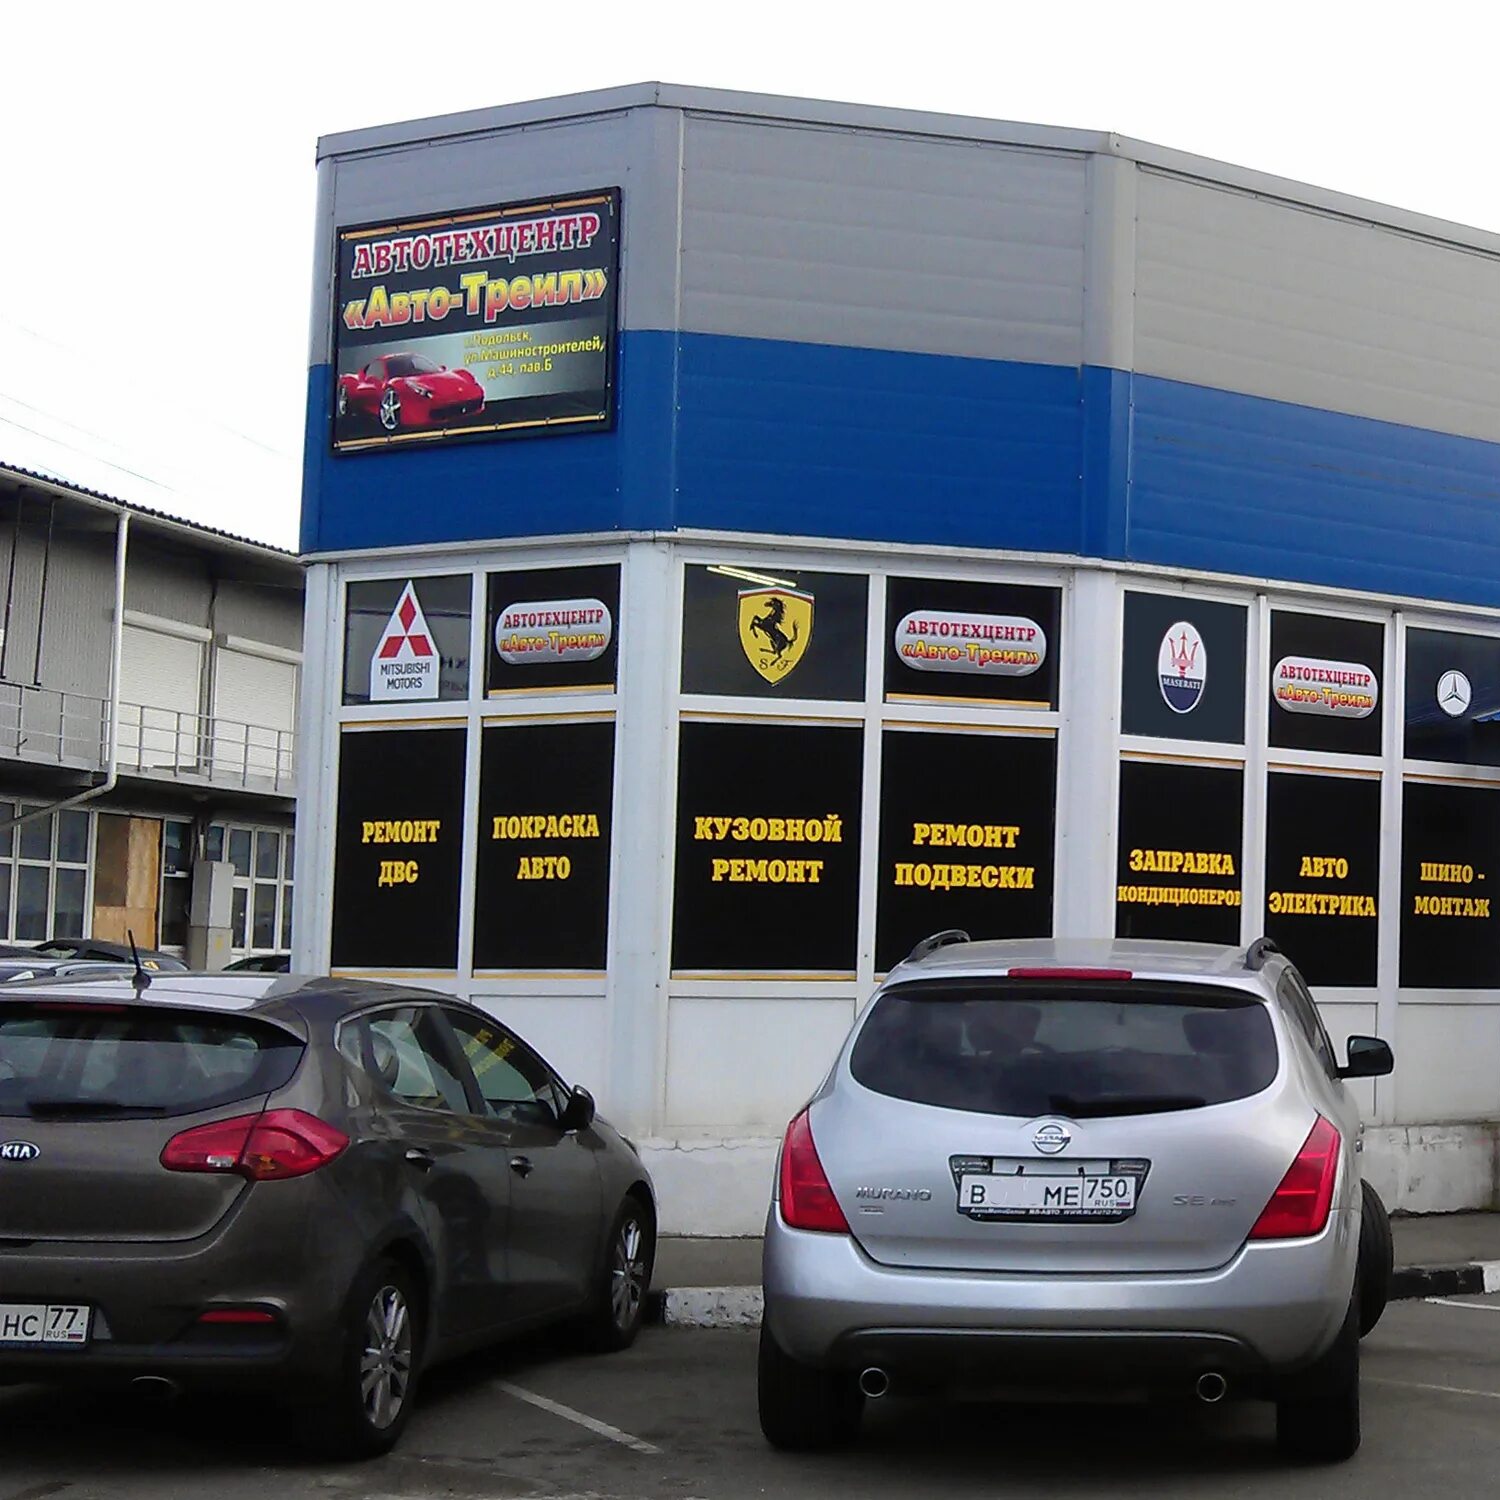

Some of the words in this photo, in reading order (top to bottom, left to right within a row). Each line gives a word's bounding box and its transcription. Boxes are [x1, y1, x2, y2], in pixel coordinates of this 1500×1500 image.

[351, 212, 601, 279] АВТОТЕХЦЕНТР
[343, 268, 608, 331] «Авто-Треил»
[503, 608, 604, 629] АВТОТЕХЦЕНТР
[906, 620, 1036, 643] АВТОТЕХЦЕНТР
[380, 662, 431, 676] MITSUBISHI
[1280, 665, 1371, 688] АВТОТЕХЦЕНТР
[386, 677, 423, 690] MOTORS
[1163, 677, 1201, 690] MASERATI
[361, 820, 441, 843] РЕМОНТ
[492, 814, 600, 839] ПОКРАСКА
[694, 814, 843, 843] КУЗОВНОЙ
[913, 823, 1020, 848] РЕМОНТ
[516, 856, 571, 880] АВТО
[711, 858, 824, 883] РЕМОНТ
[1129, 848, 1236, 876] ЗАПРАВКА
[1299, 855, 1349, 880] АВТО
[378, 861, 419, 887] ДВС
[894, 863, 1035, 891] ПОДВЕСКИ
[1268, 892, 1377, 918] ЭЛЕКТРИКА
[1414, 895, 1491, 919] МОНТАЖ
[1, 1144, 31, 1159] KIA
[855, 1186, 933, 1202] MURANO
[1086, 1178, 1128, 1199] 750
[1094, 1199, 1115, 1207] RUS
[50, 1308, 79, 1330] 77
[45, 1330, 67, 1339] RUS
